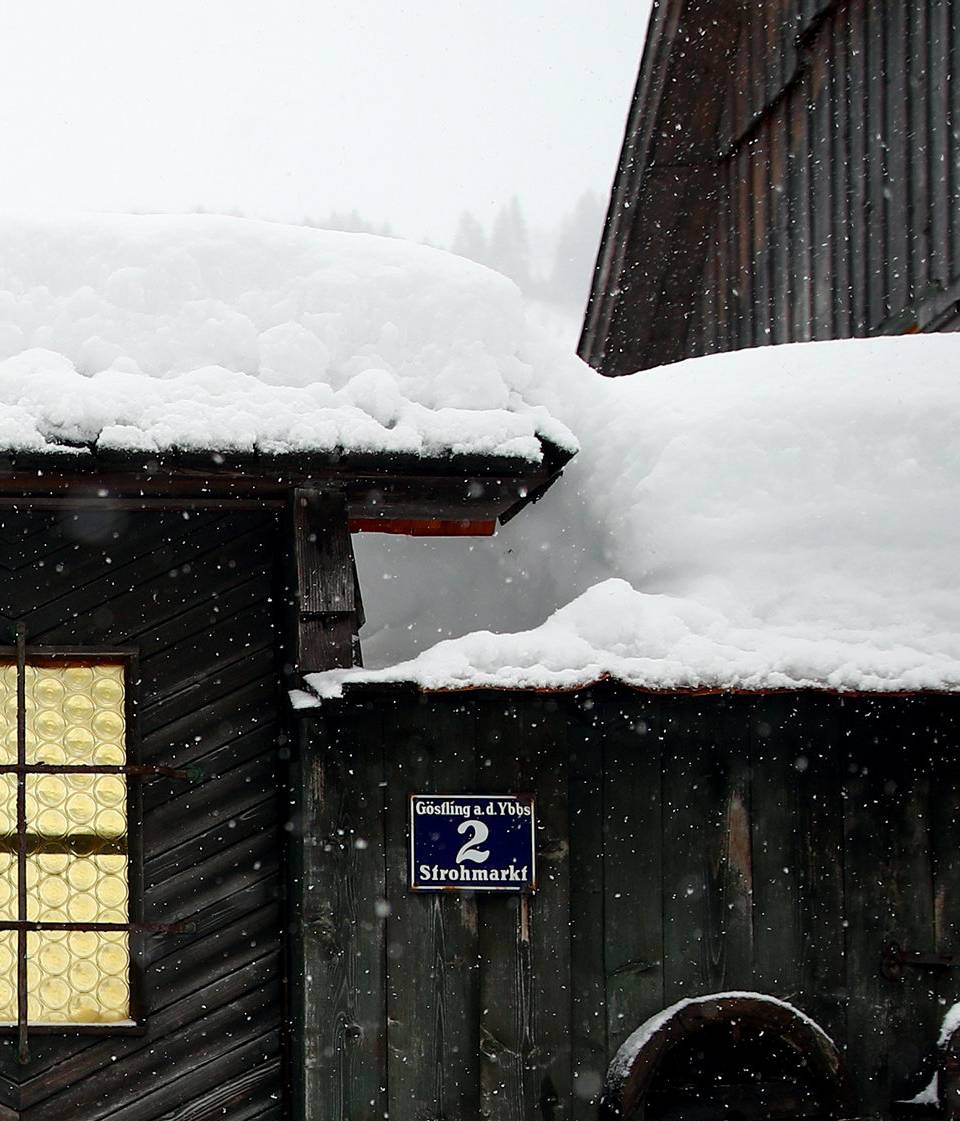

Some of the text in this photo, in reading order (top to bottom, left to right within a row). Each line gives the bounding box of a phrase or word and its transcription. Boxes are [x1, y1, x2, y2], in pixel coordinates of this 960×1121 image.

[416, 800, 471, 818] Göstling
[455, 819, 490, 864] 2
[419, 864, 528, 881] Strohmarkt
